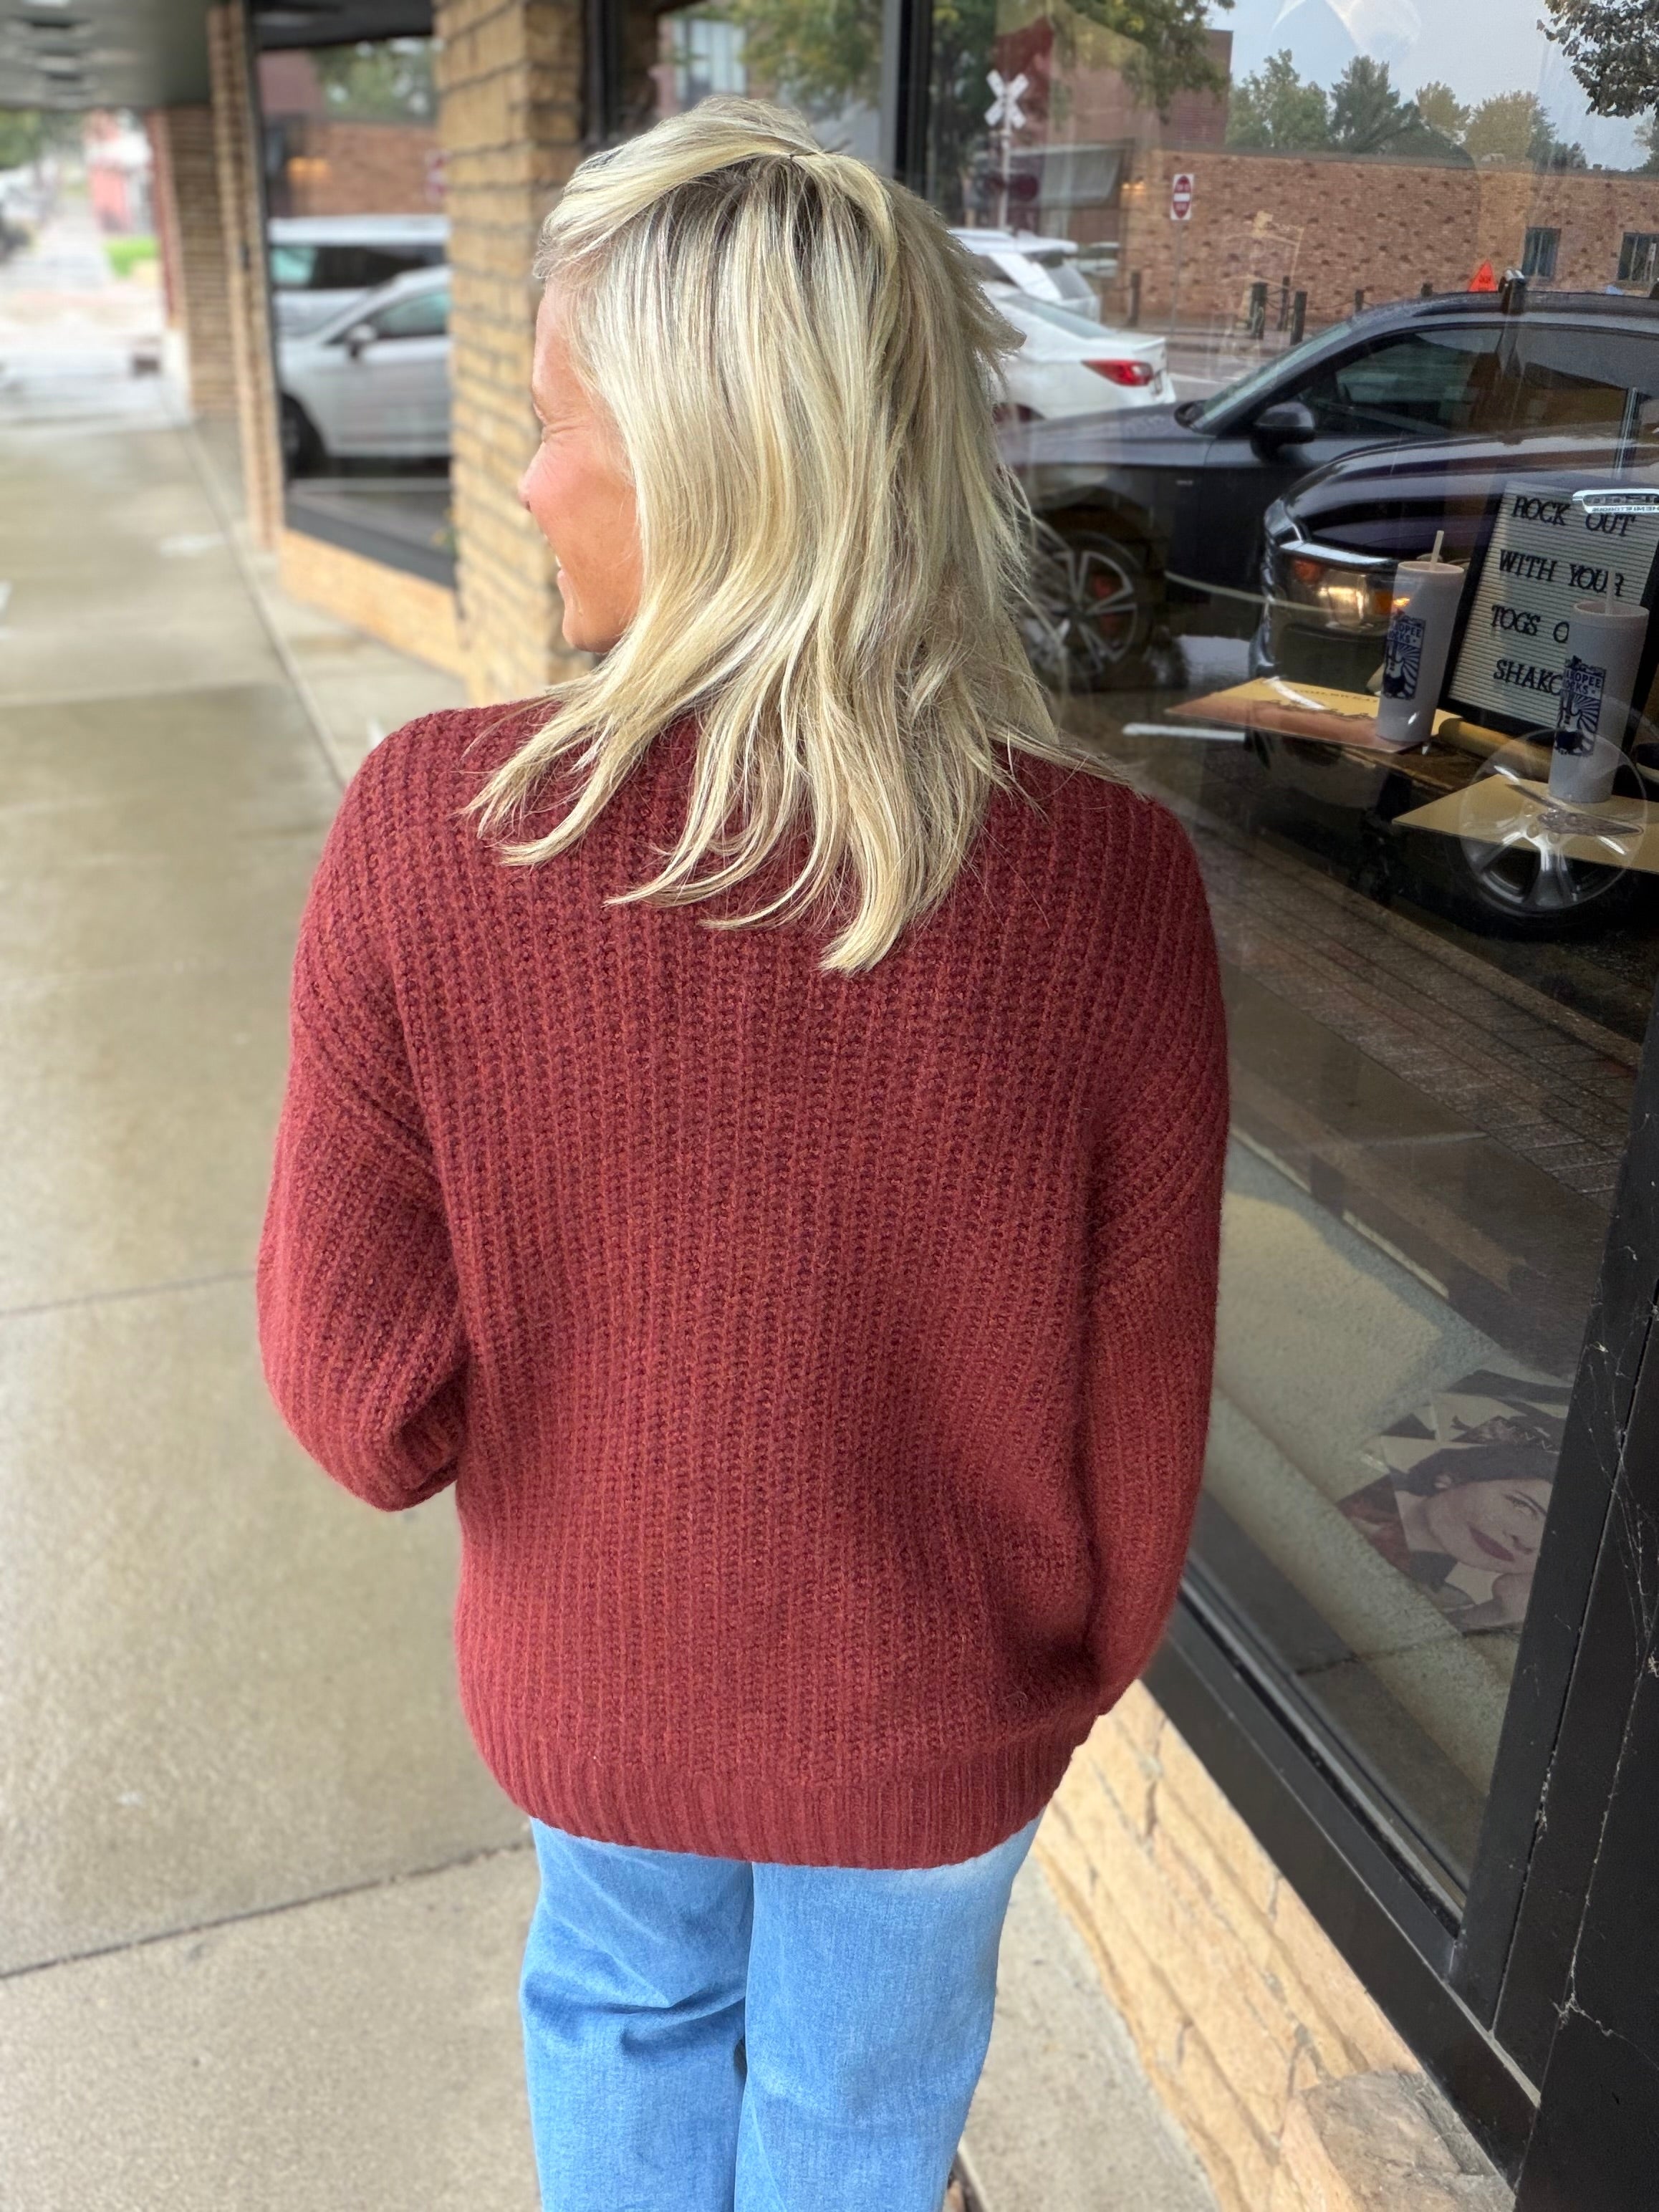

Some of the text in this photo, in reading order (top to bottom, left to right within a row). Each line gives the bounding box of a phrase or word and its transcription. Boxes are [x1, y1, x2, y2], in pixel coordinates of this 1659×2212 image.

[1512, 495, 1637, 537] ROCK OUT
[1499, 549, 1557, 582] WITH
[1491, 605, 1541, 635] TOGS
